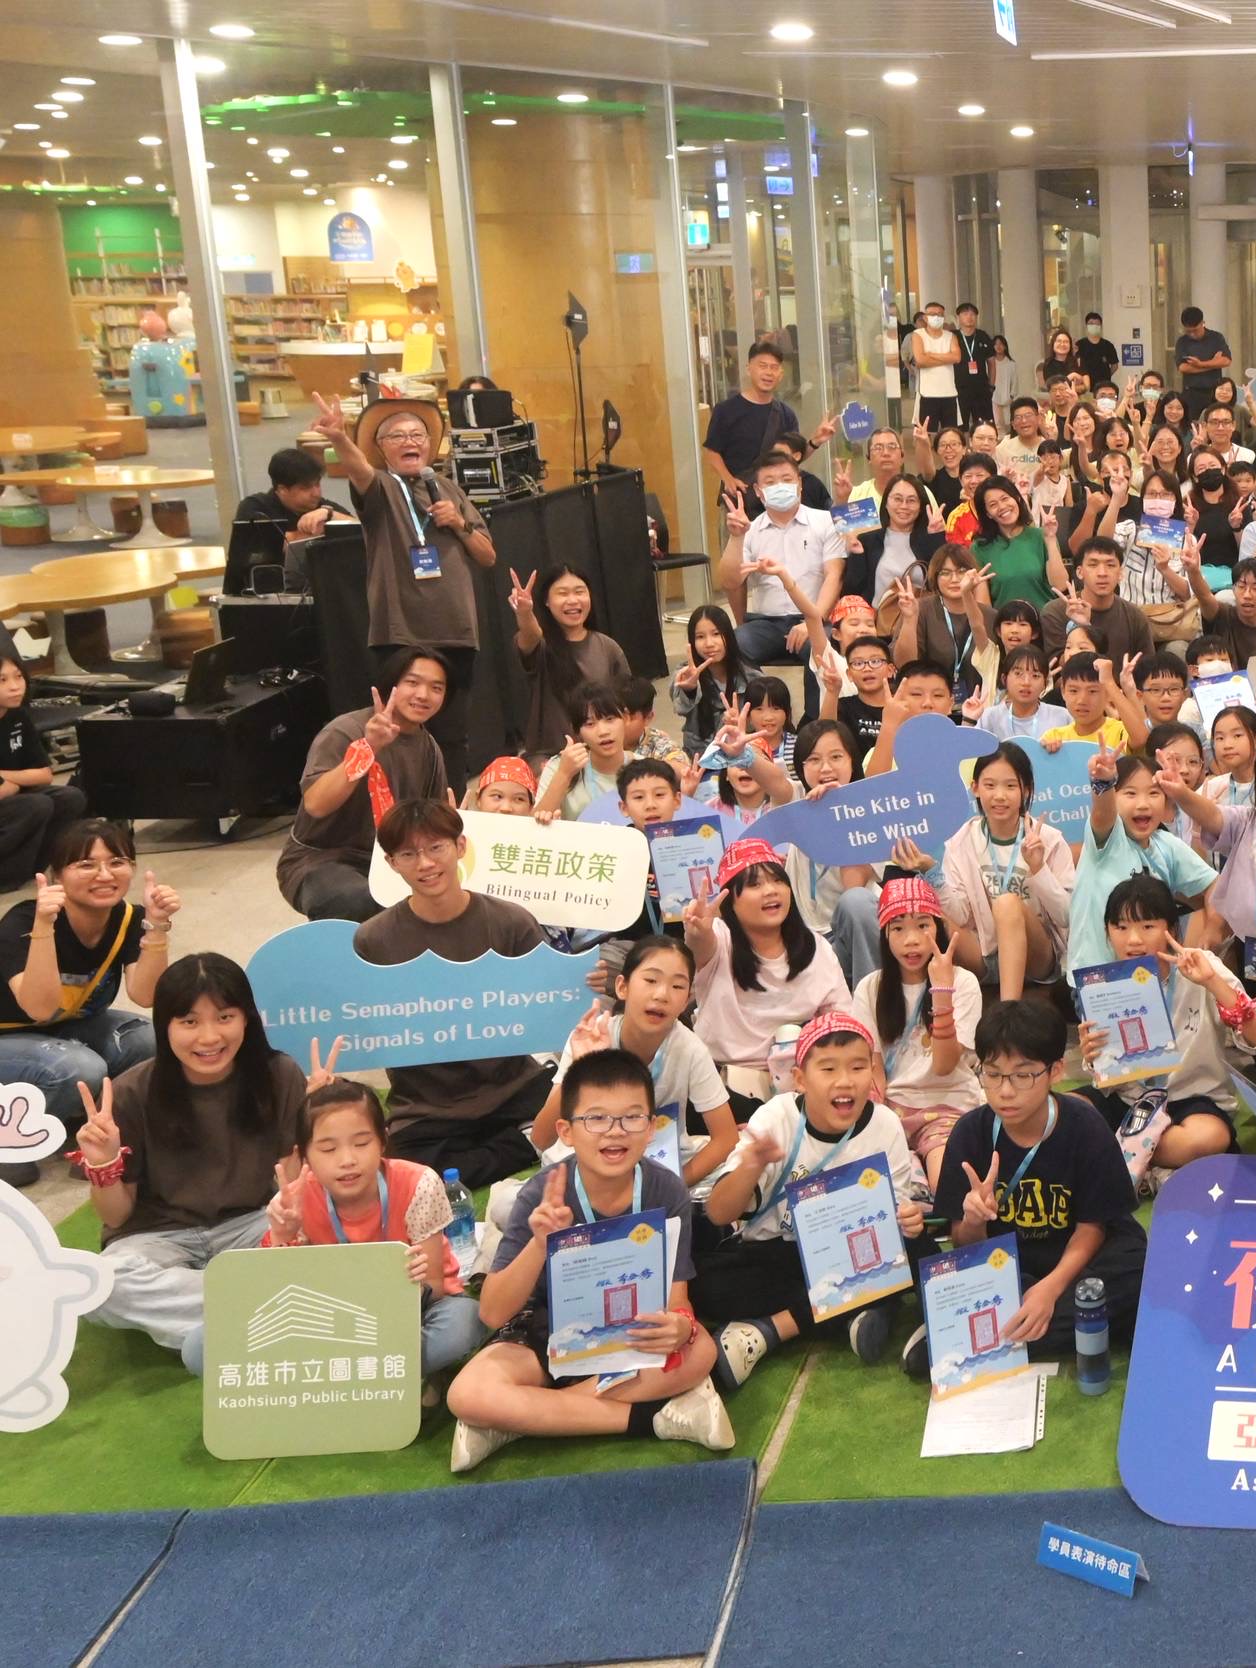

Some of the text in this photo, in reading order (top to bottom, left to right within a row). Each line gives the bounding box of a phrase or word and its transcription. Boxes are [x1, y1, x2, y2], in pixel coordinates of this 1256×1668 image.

[1011, 453, 1041, 464] adid
[829, 789, 935, 821] The Kite in
[1060, 783, 1092, 798] Oce
[1049, 804, 1090, 823] Chall
[848, 817, 929, 847] the Wind
[488, 842, 618, 885] 雙語政策
[485, 882, 613, 909] Bilingual Policy
[264, 986, 581, 1028] Little Semaphore Players:
[338, 1020, 525, 1052] Signals of Love
[218, 1353, 406, 1388] 高雄市立圖書館
[1216, 1344, 1237, 1373] A
[218, 1385, 405, 1410] Kaohsiung Public Library
[1047, 1536, 1132, 1580] 學員表演待命區
